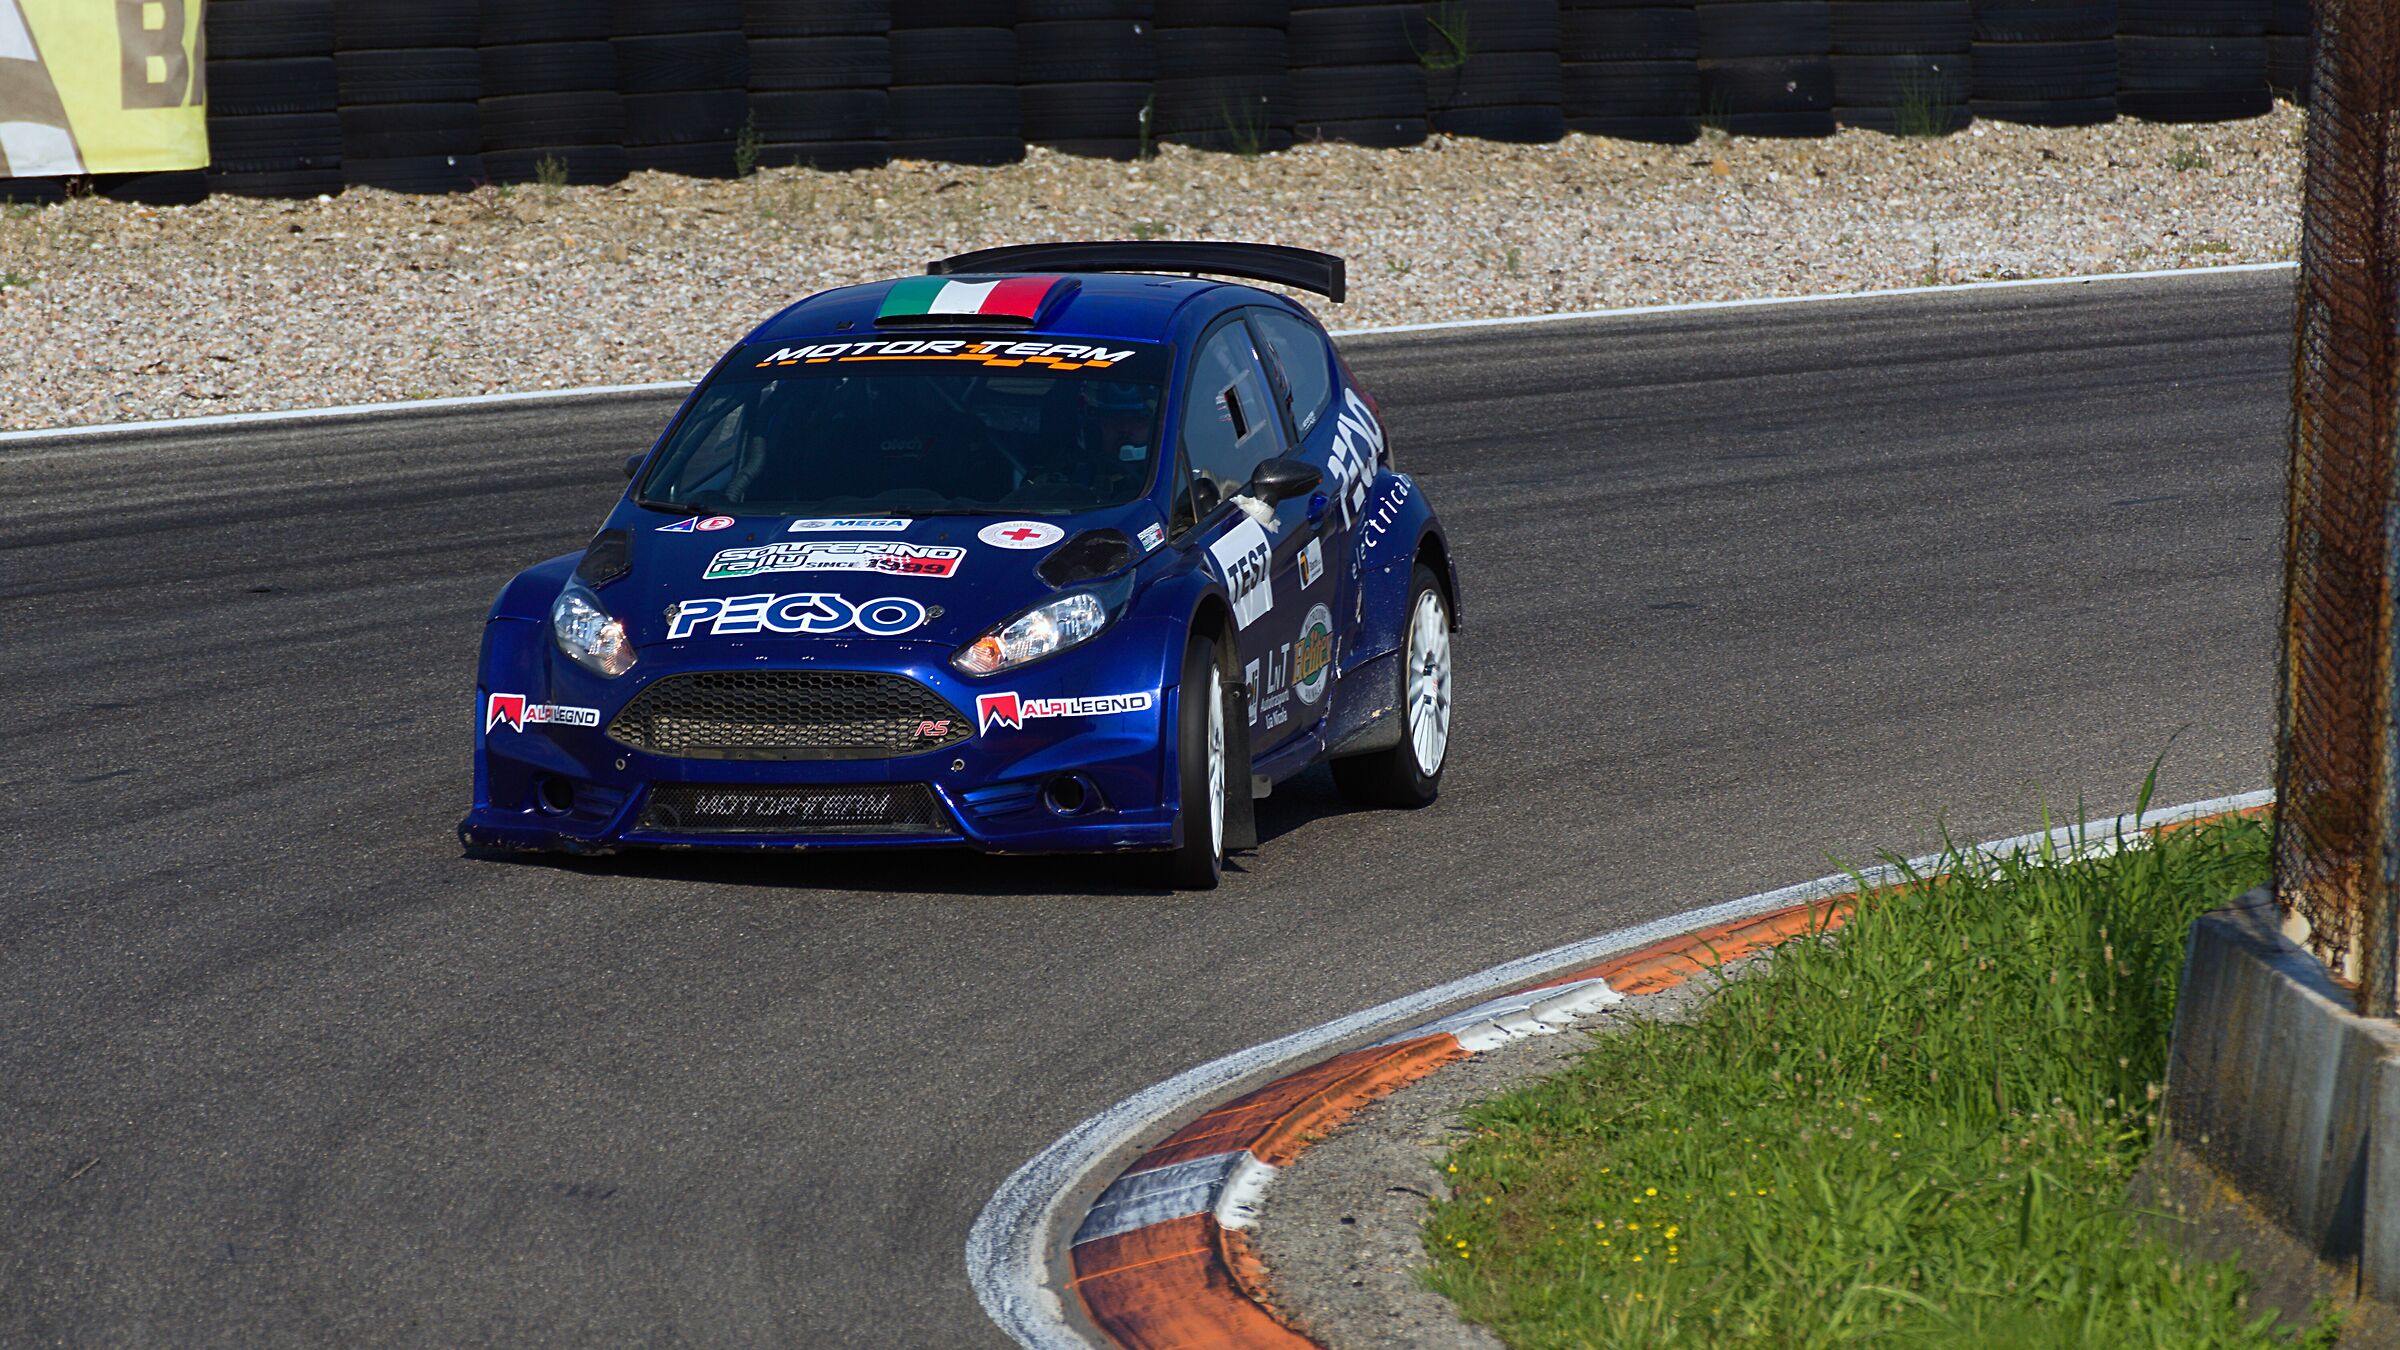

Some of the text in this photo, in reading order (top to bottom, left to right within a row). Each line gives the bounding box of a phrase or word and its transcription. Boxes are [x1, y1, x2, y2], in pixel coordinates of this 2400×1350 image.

[717, 542, 961, 560] SOLFERINO
[710, 553, 808, 573] rally
[805, 556, 946, 575] SINCE 1999
[1227, 541, 1268, 604] TEST
[669, 594, 926, 639] PECSO
[1023, 695, 1147, 717] ALPILEGNO
[914, 720, 950, 737] RS
